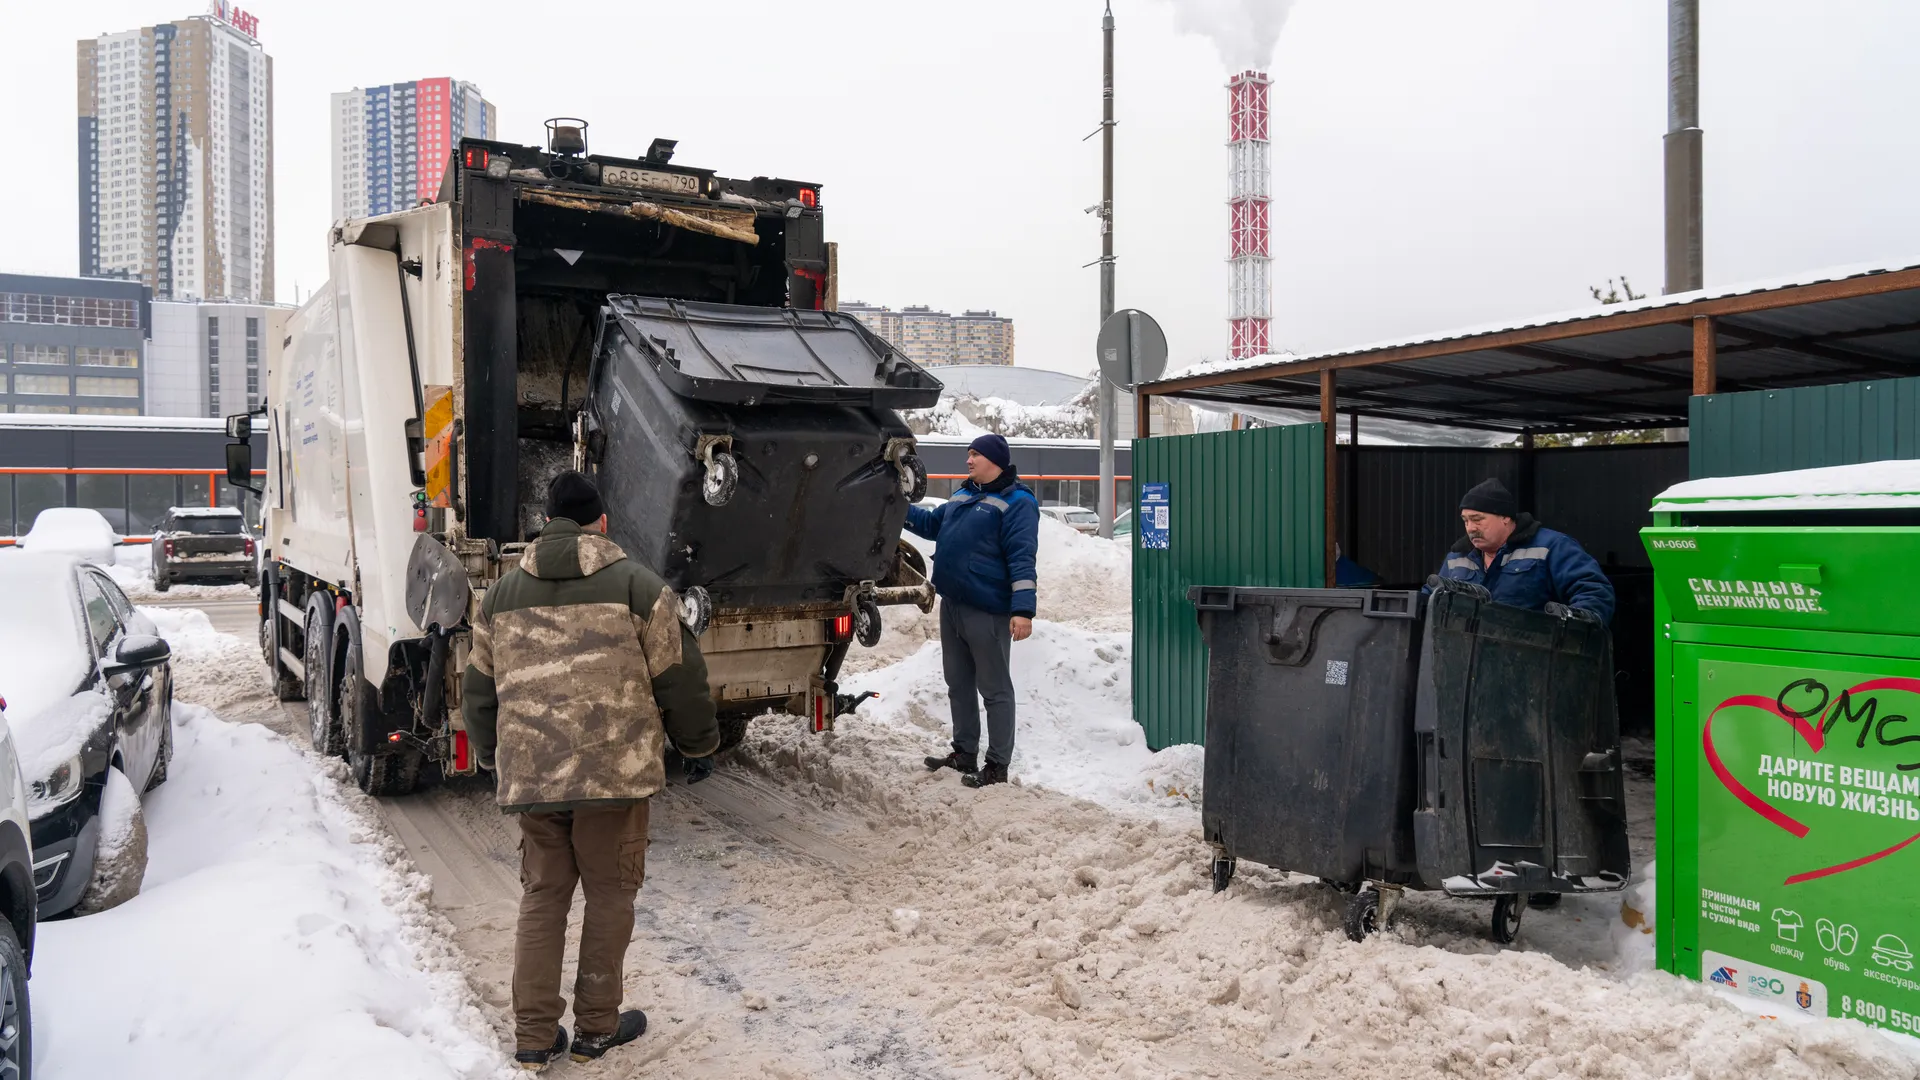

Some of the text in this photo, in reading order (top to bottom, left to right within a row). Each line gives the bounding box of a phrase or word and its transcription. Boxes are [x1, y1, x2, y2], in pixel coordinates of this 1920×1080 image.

[672, 175, 697, 190] 790
[1653, 540, 1696, 549] М-0606
[1694, 594, 1823, 612] НЕНУЖНУЮ ОДЕ
[1758, 754, 1920, 797] ДАРИТЕ ВЕЩАМ
[1767, 778, 1920, 821] НОВУЮ ЖИЗНЬ
[1702, 888, 1760, 912] ПРИНИМАЕМ
[1709, 902, 1740, 917] чистом
[1709, 911, 1735, 926] сухом
[1737, 919, 1760, 932] виде
[1770, 943, 1804, 961] одежду
[1823, 956, 1850, 972] обувь
[1841, 995, 1852, 1012] 8
[1855, 999, 1887, 1023] 800
